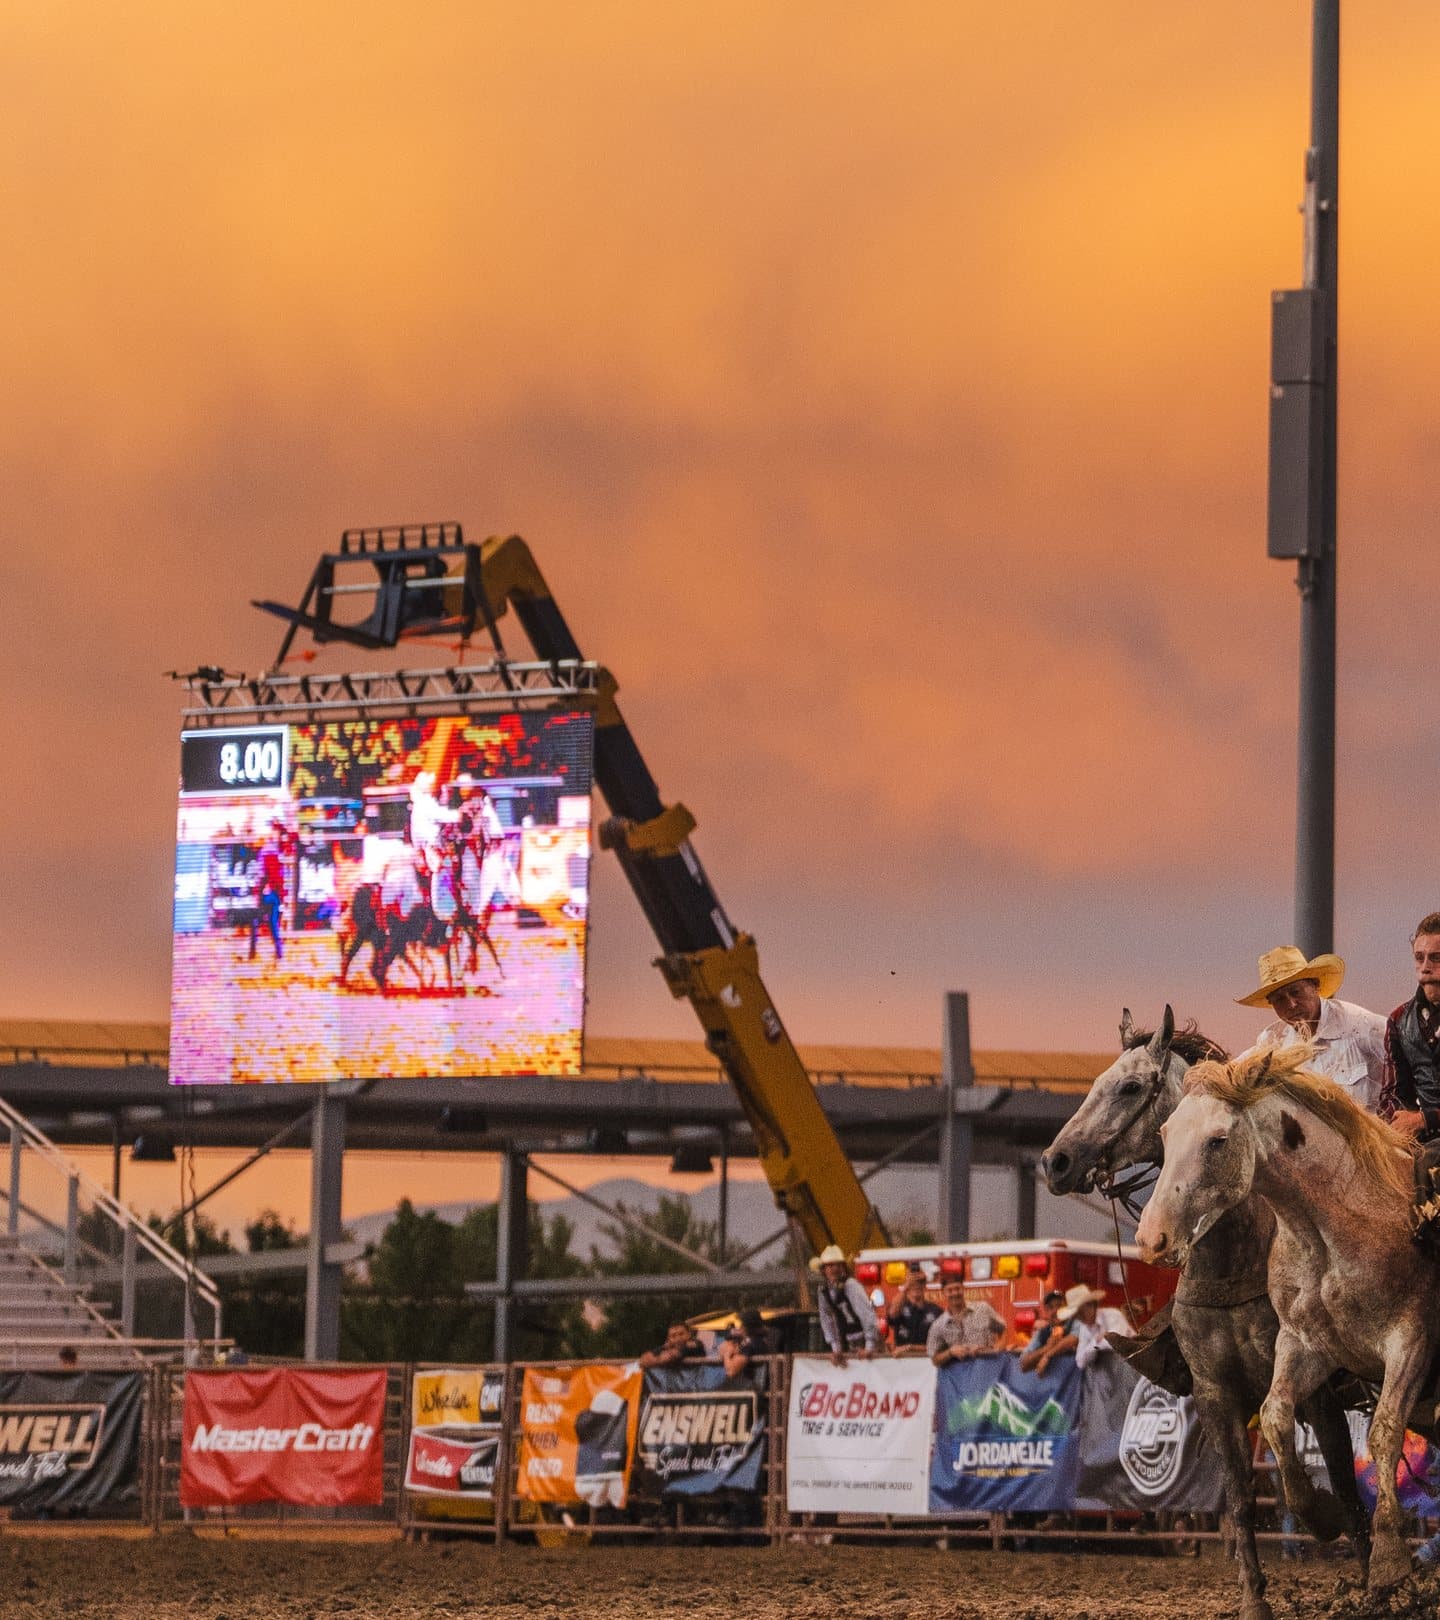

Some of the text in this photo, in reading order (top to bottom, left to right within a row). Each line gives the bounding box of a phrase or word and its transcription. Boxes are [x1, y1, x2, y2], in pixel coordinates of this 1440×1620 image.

[219, 741, 280, 784] 8.00
[190, 1422, 374, 1452] MasterCraft
[642, 1403, 755, 1445] ENSWELL
[837, 1421, 884, 1437] SERVICE
[655, 1445, 691, 1480] Speed
[691, 1448, 715, 1471] and
[952, 1439, 1055, 1471] JORDANELLE
